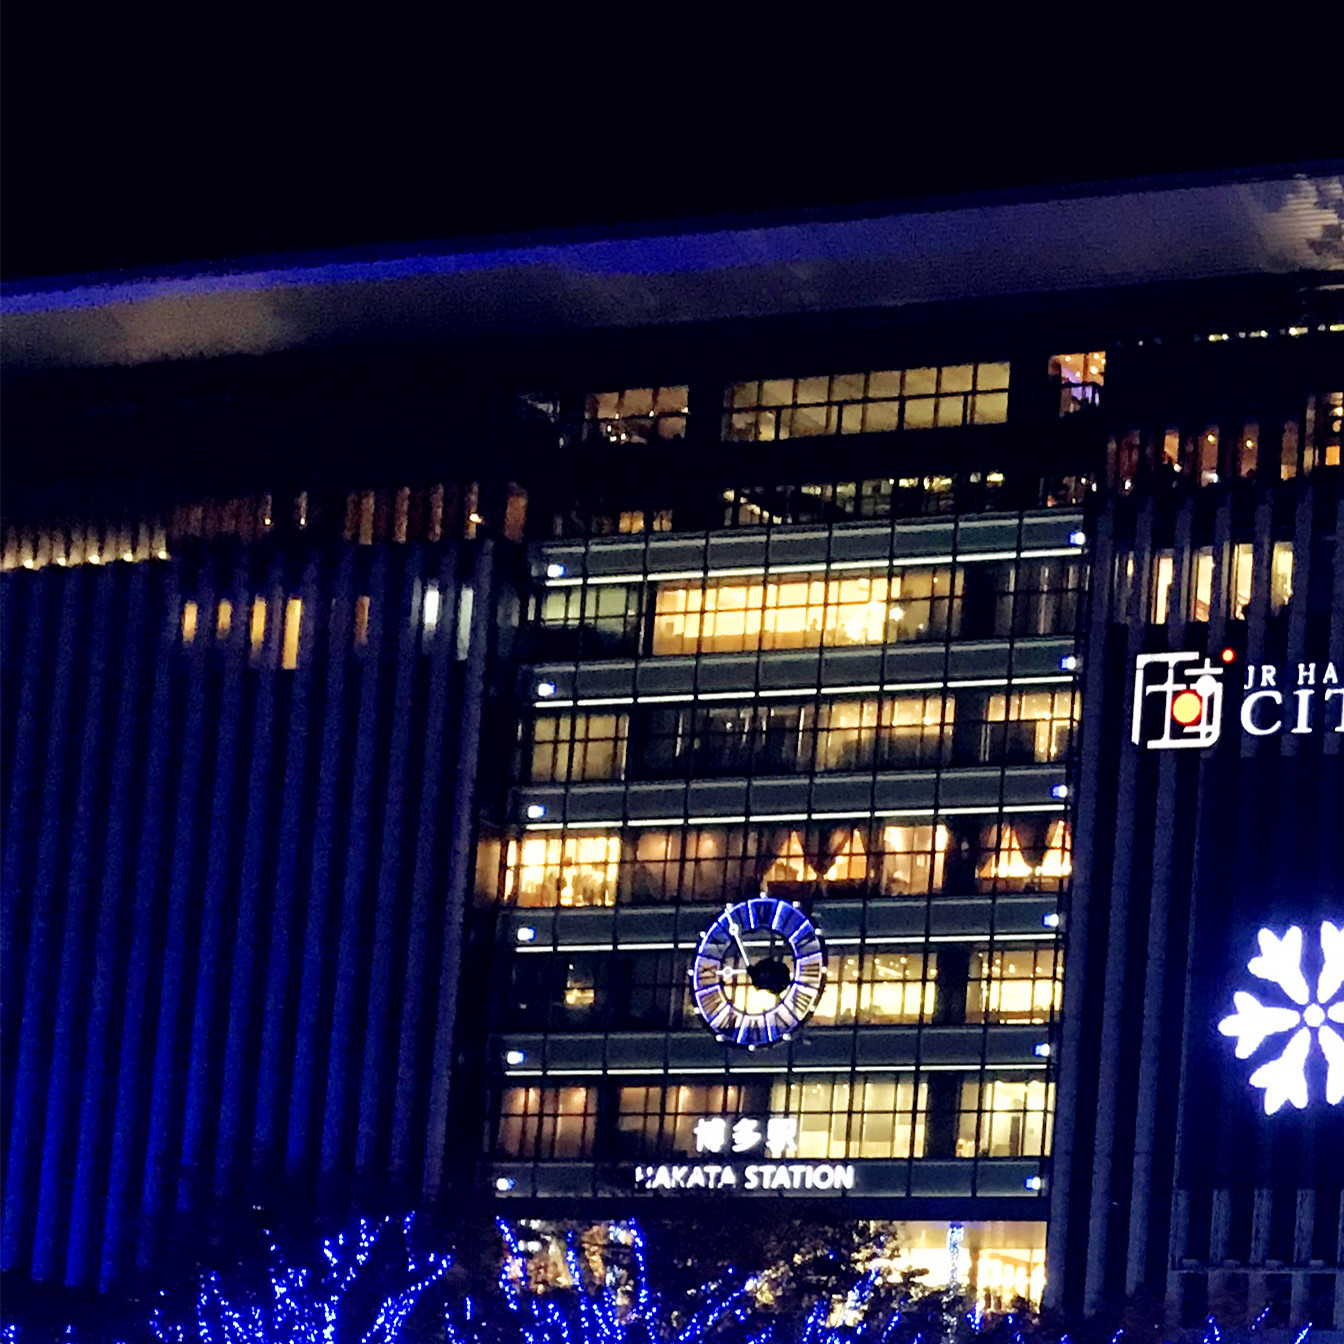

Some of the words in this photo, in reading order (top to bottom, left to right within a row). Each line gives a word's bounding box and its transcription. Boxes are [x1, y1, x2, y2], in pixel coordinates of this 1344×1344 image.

[1243, 664, 1277, 690] JR
[634, 1164, 737, 1190] HAKATA
[744, 1164, 855, 1190] STATION
